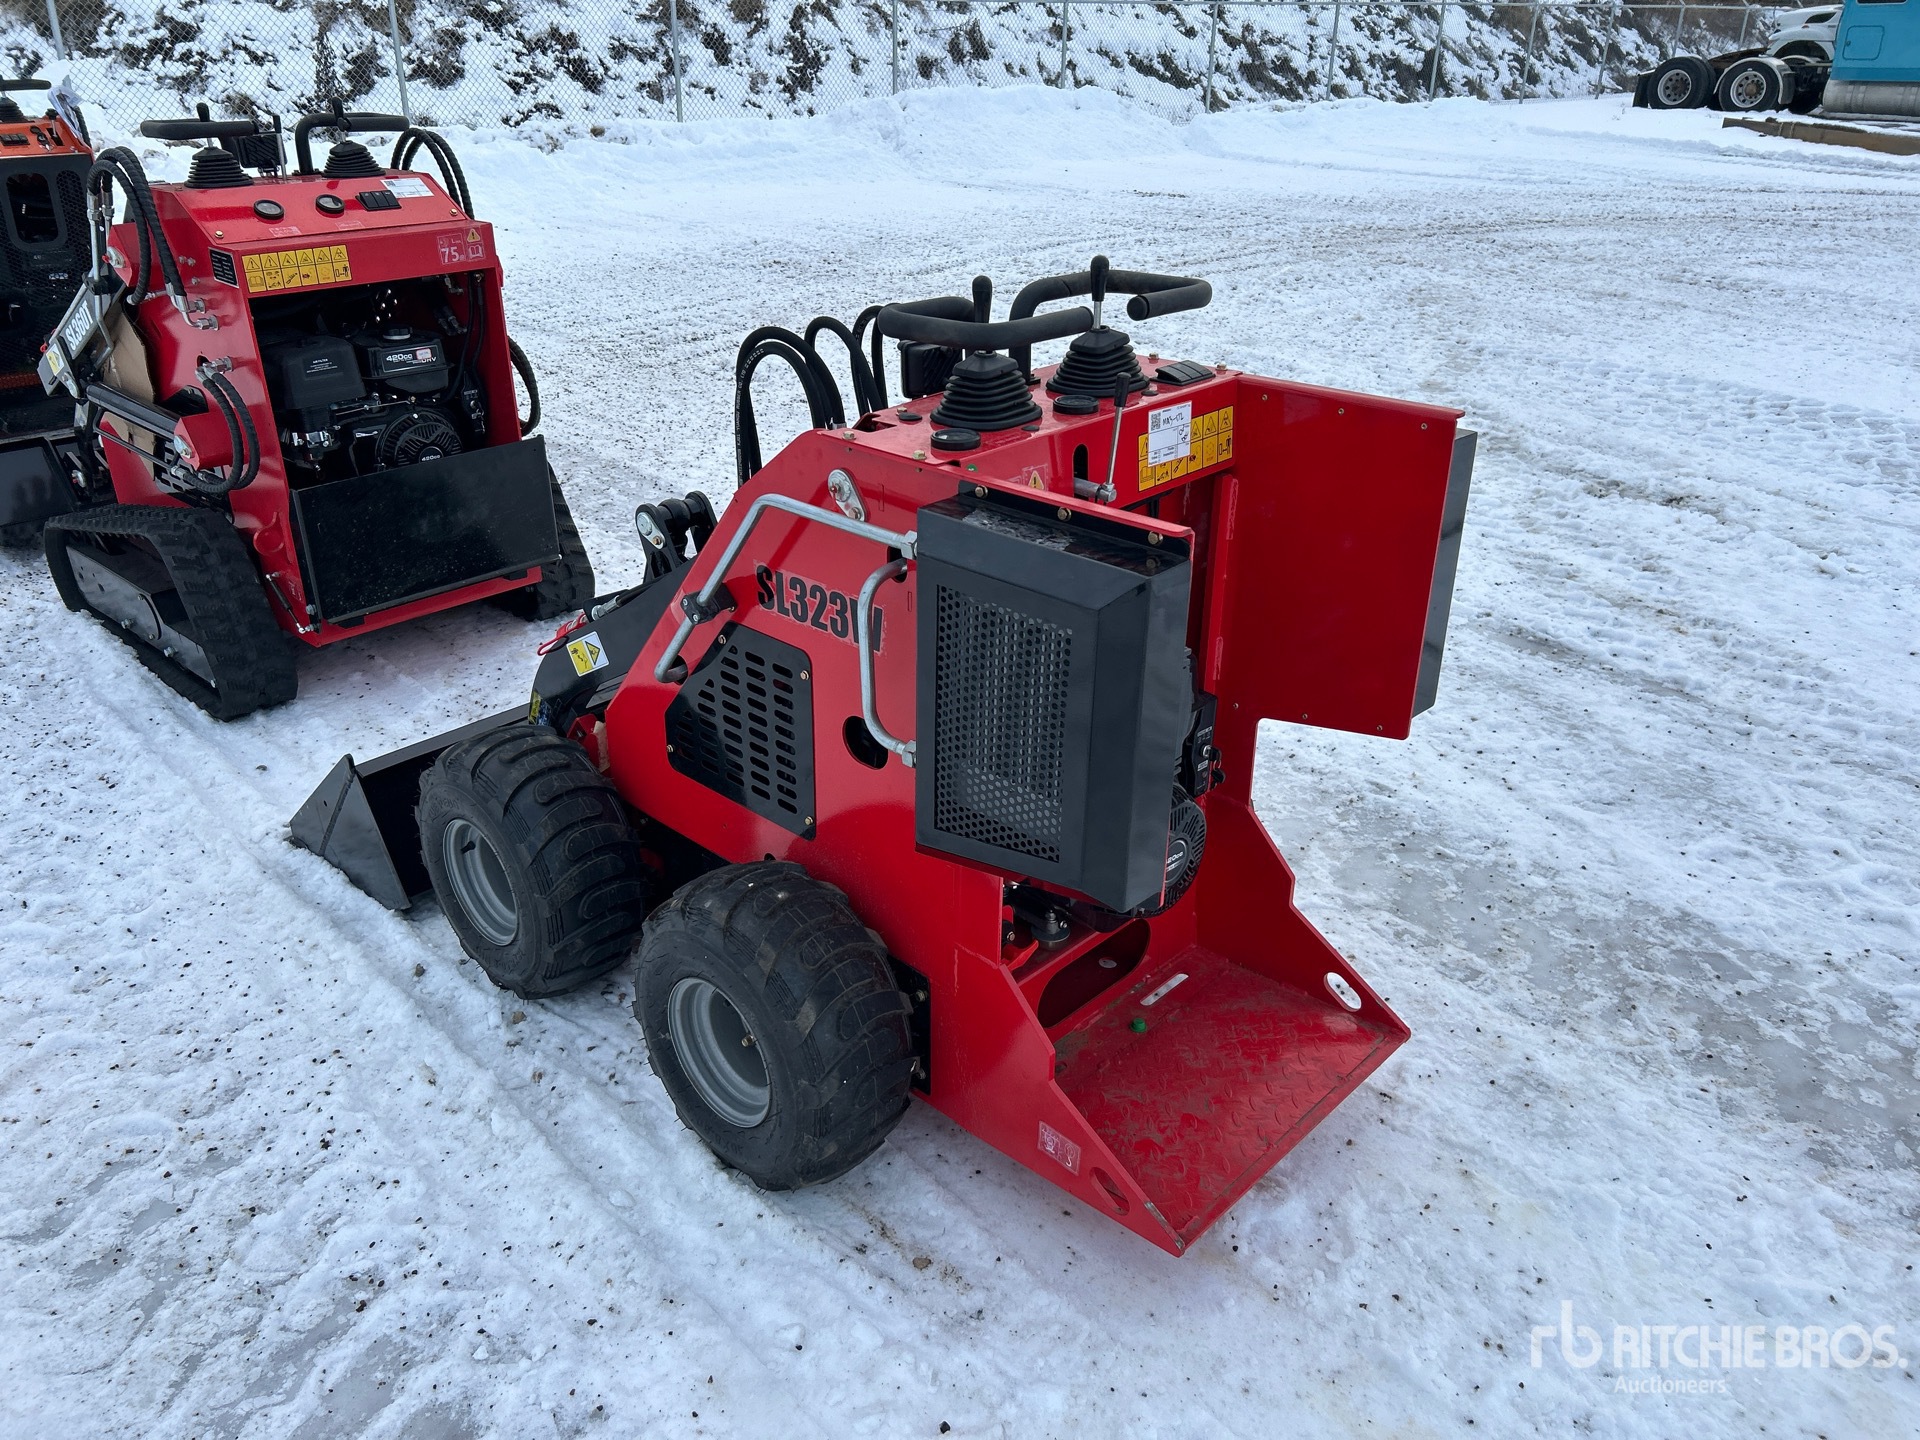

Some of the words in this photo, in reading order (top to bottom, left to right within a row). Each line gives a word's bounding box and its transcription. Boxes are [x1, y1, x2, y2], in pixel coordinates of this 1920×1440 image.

[440, 246, 460, 263] 75
[65, 300, 93, 350] SL360T
[756, 565, 883, 652] SL323W
